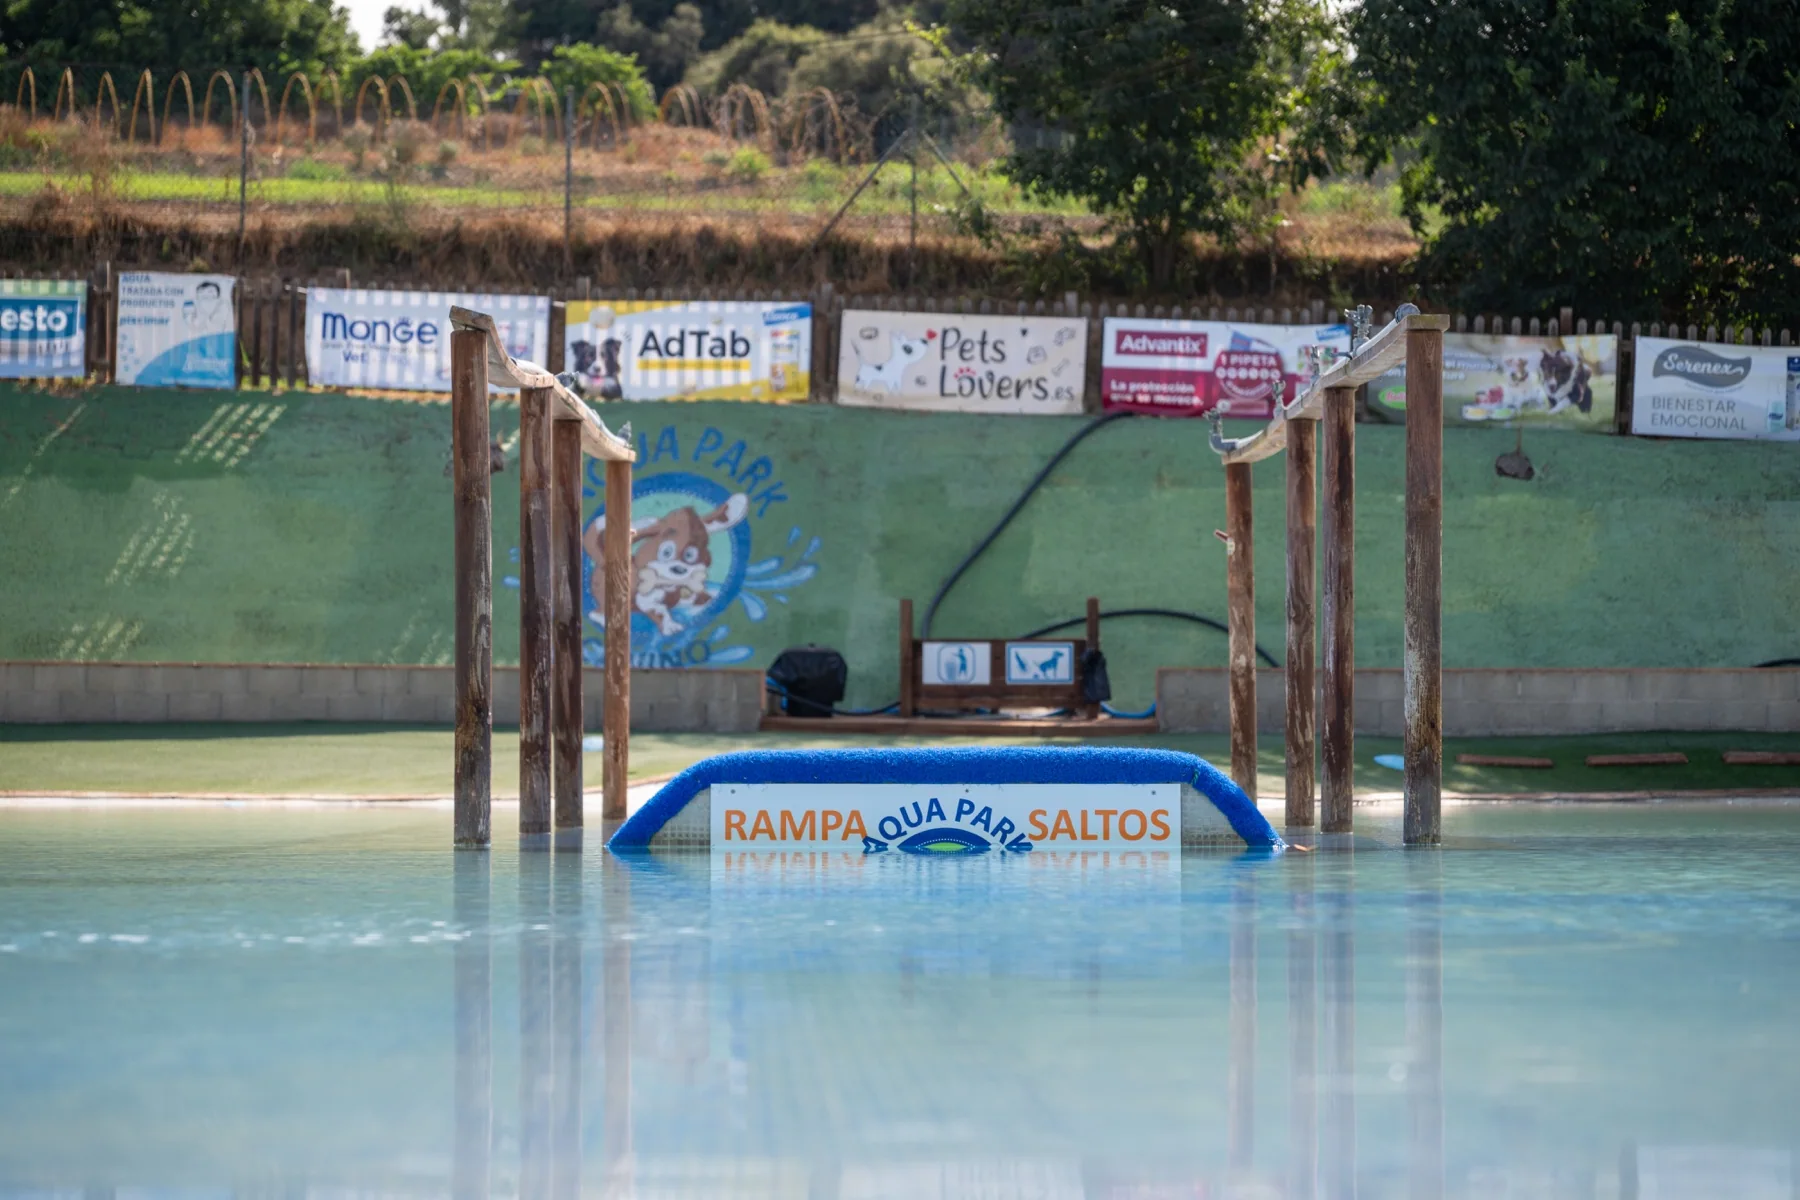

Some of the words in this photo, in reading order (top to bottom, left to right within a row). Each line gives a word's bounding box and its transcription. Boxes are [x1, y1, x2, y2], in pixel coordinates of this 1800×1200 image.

[638, 329, 751, 358] AdTab
[939, 327, 1006, 364] Pets
[1119, 334, 1200, 354] Advantix
[1663, 353, 1744, 376] Serenex
[1652, 396, 1736, 413] BIENESTAR
[1651, 413, 1747, 431] EMOCIONAL
[692, 426, 789, 518] PARK
[724, 809, 868, 842] RAMPA
[862, 797, 946, 852] AQUA
[954, 798, 1034, 852] PARK
[1027, 808, 1171, 842] SALTOS
